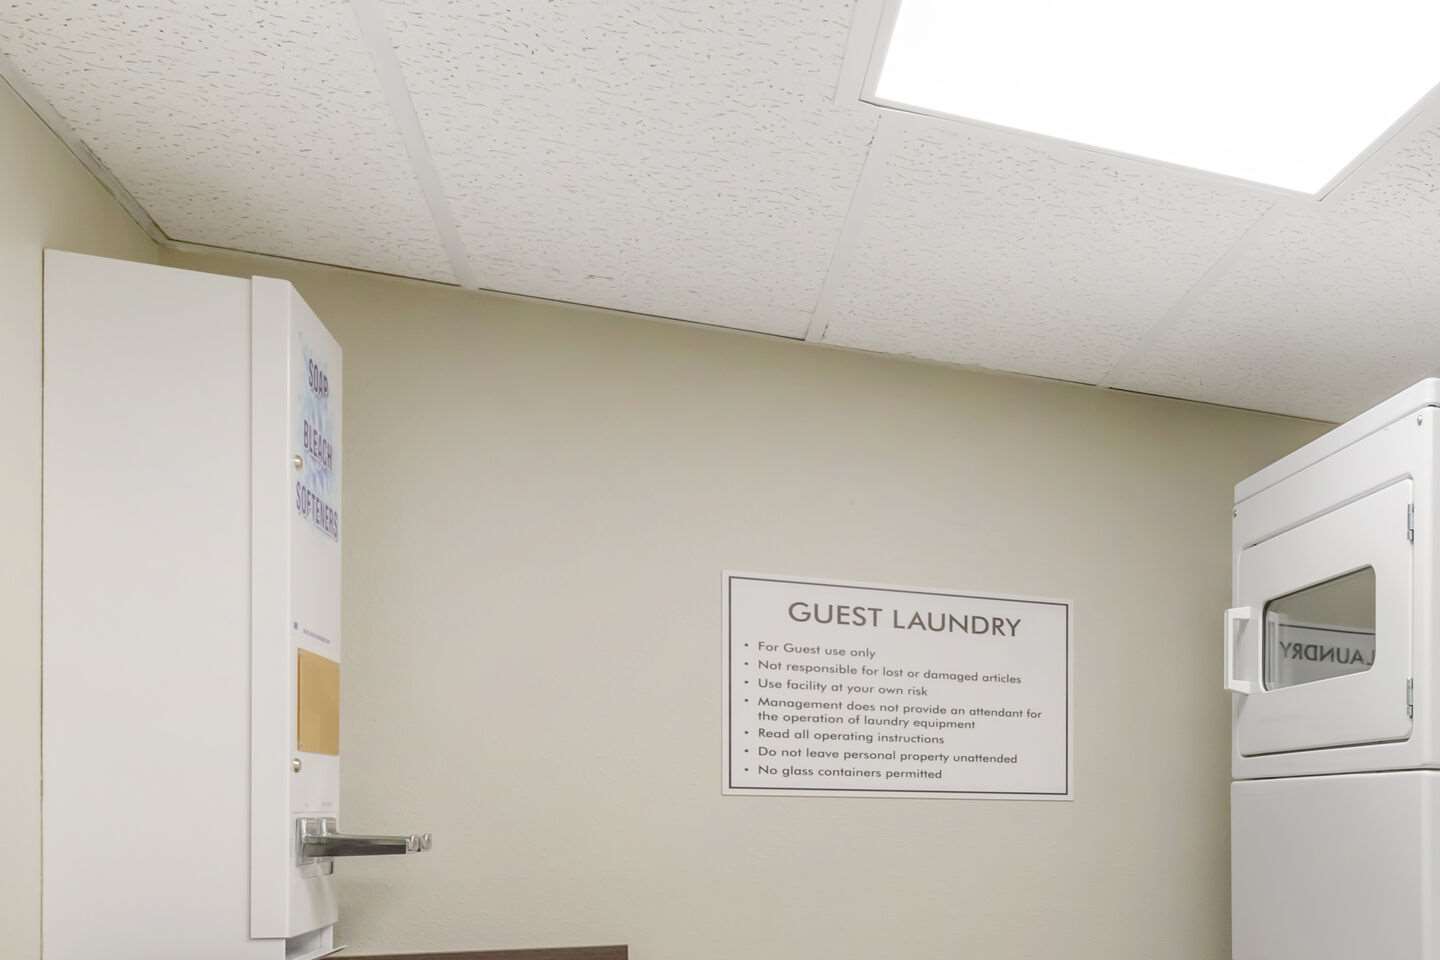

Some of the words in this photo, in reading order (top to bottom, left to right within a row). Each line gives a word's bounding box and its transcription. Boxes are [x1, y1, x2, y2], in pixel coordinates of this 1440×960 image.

[308, 358, 329, 398] SOAP
[303, 420, 333, 470] BLEACH
[296, 481, 339, 539] SOFTENERS
[788, 601, 883, 627] GUEST
[893, 609, 1021, 637] LAUNDRY
[758, 641, 779, 652] For
[784, 642, 820, 655] Guest
[825, 648, 846, 656] use
[850, 647, 876, 660] only
[758, 660, 782, 671] Not
[786, 663, 857, 676] responsible
[862, 665, 879, 676] for
[883, 666, 904, 678] lost
[923, 670, 978, 683] damaged
[982, 674, 1022, 684] articles
[758, 678, 782, 689] Use
[786, 679, 827, 693] facility
[831, 683, 843, 692] at
[847, 685, 874, 698] your
[878, 687, 904, 695] own
[907, 686, 928, 696] risk
[758, 697, 842, 710] Management
[847, 700, 876, 712] does
[880, 703, 899, 713] not
[903, 704, 947, 715] provide
[950, 707, 965, 716] an
[969, 707, 1023, 719] attendant
[1027, 709, 1043, 719] for
[758, 711, 778, 721] the
[782, 713, 844, 724] operation
[848, 715, 861, 725] of
[864, 715, 909, 728] laundry
[913, 719, 975, 730] equipment
[758, 728, 790, 739] Read
[794, 729, 809, 739] all
[814, 731, 873, 744] operating
[878, 732, 944, 744] instructions
[758, 746, 777, 757] Do
[781, 748, 801, 757] not
[806, 747, 839, 758] leave
[843, 750, 896, 761] personal
[900, 752, 949, 764] property
[953, 753, 1018, 764] unattended
[758, 765, 778, 775] No
[782, 766, 814, 777] glass
[818, 768, 881, 778] containers
[885, 769, 942, 779] permitted
